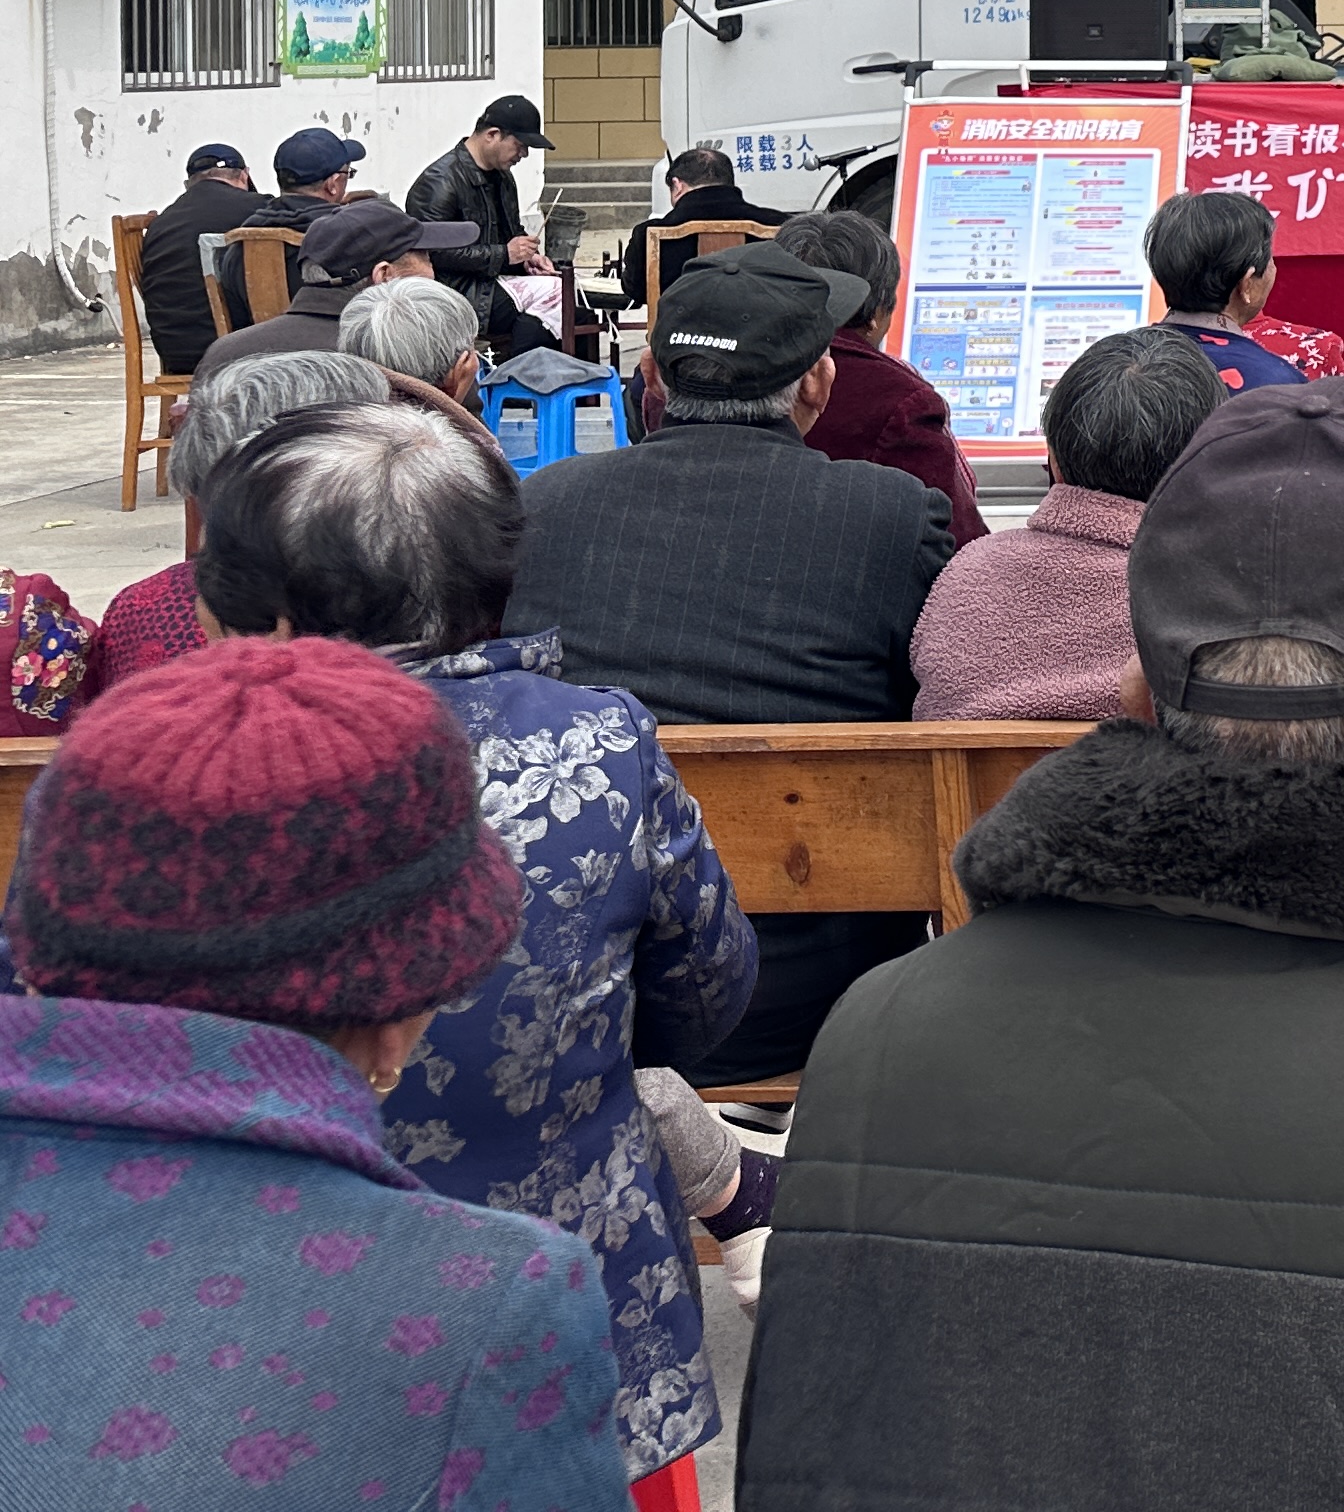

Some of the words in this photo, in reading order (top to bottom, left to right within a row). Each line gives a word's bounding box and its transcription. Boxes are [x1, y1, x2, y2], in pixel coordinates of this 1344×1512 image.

[960, 118, 1144, 143] 消防安全知识教育
[736, 133, 814, 154] 限载3人
